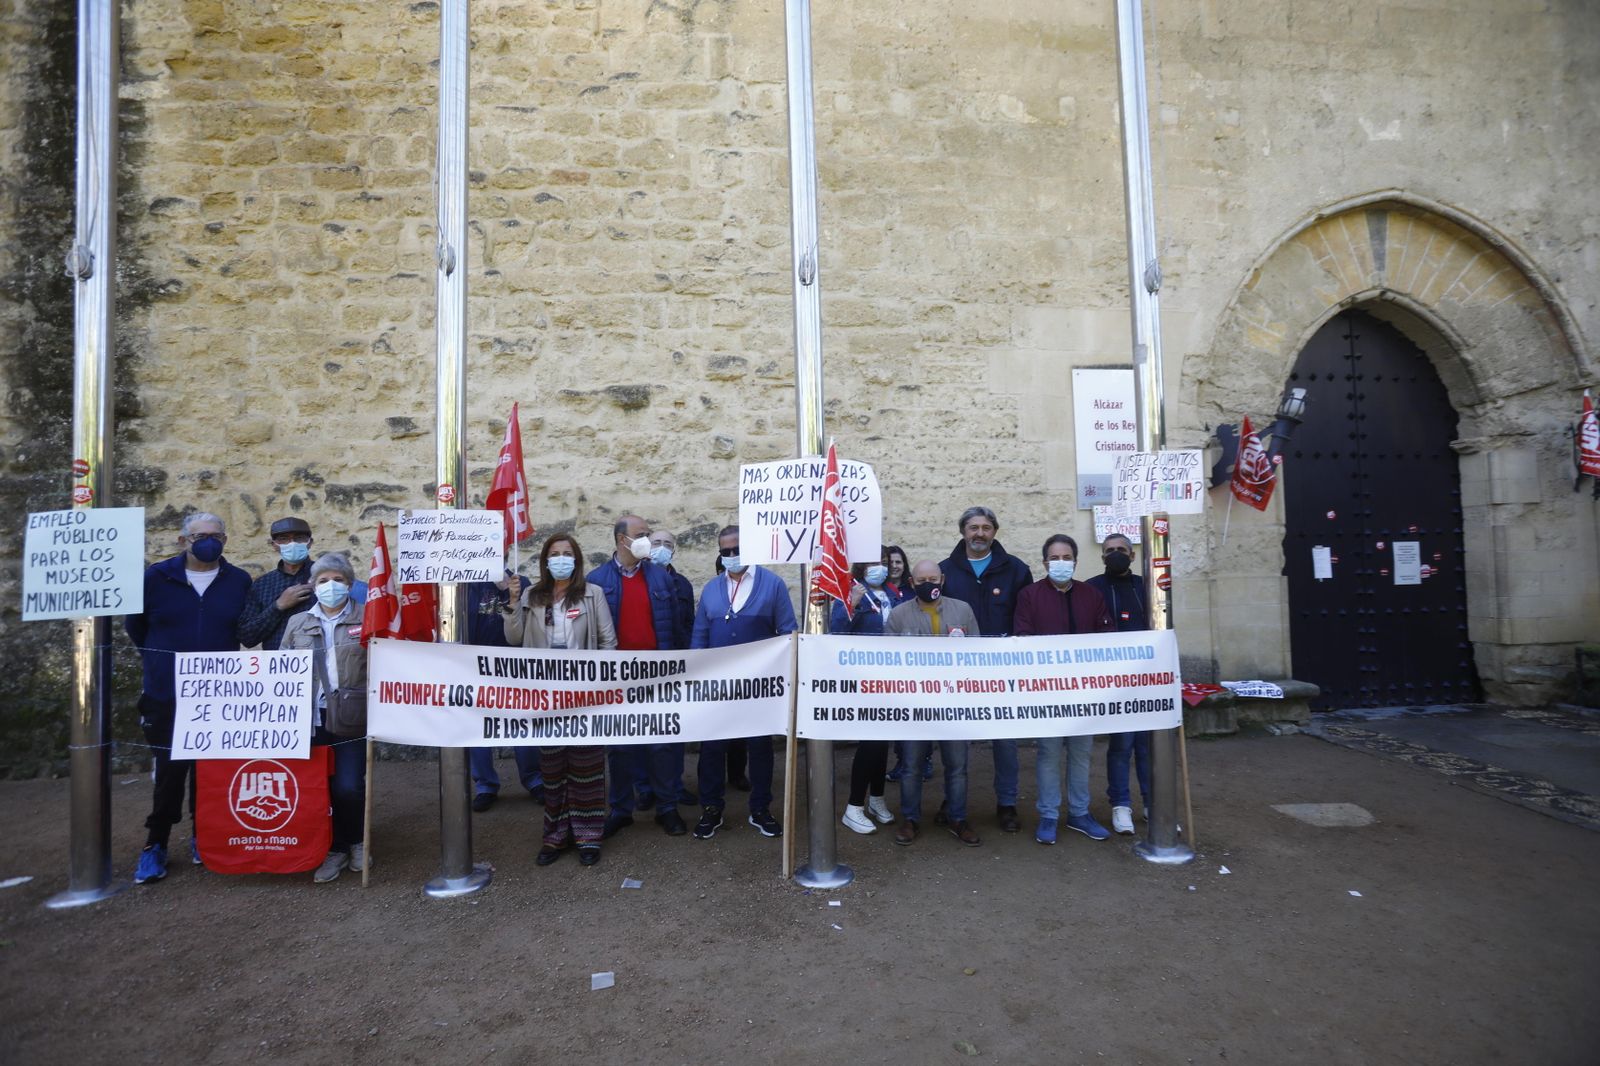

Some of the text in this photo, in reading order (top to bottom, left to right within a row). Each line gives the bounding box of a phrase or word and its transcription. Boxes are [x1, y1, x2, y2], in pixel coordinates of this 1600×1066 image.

[1093, 399, 1124, 410] Alcázar
[1094, 420, 1137, 432] de los Rey
[1095, 440, 1136, 451] Cristianos
[743, 463, 867, 484] MAS ORDENAZAS
[1146, 466, 1158, 482] LE
[742, 484, 870, 504] PARA LOS MEOS
[1117, 485, 1128, 501] DE
[1131, 484, 1146, 501] SU
[30, 512, 86, 529] EMPLEO
[400, 513, 438, 525] Servicios
[757, 509, 858, 526] MUNICIPS
[53, 525, 118, 545] PÚBLICO
[31, 547, 114, 568] PARA LOS
[400, 551, 426, 560] menos
[46, 567, 115, 584] MUSEOS
[400, 565, 489, 581] MÁS EN PLANTILLA
[25, 587, 123, 613] MUNICIPALES
[179, 653, 309, 675] LLEVAMOS 3 AÑOS
[838, 645, 1155, 666] CÓRDOBA CIUDAD PATRIMONIO DE LA HUMANIDAD
[477, 655, 686, 681] EL AYUNTAMIENTO DE CÓRDOBA
[180, 679, 305, 698] ESPERANDO QUE
[811, 679, 837, 693] POR
[840, 680, 857, 693] UN
[860, 680, 918, 694] SERVICIO
[919, 680, 941, 694] 100
[956, 678, 1006, 693] PÚBLICO
[1008, 679, 1015, 693] Y
[1018, 677, 1079, 693] PLANTILLA
[1081, 671, 1175, 690] PROPORCIONADA
[379, 675, 785, 711] INCUMPLE LOS ACUERDOS FIRMADOS CON LOS TRABAJADORES
[191, 701, 298, 723] SE CUMPLAN
[813, 697, 1175, 721] EN LOS MUSEOS MUNICIPALES DEL AYUNTAMIENTO DE CÓRDOBA
[483, 712, 681, 739] DE LOS MUSEOS MUNICIPALES
[183, 729, 300, 750] LOS ACUERDOS
[239, 772, 289, 801] UGT
[228, 835, 262, 846] mano
[270, 835, 298, 845] mano
